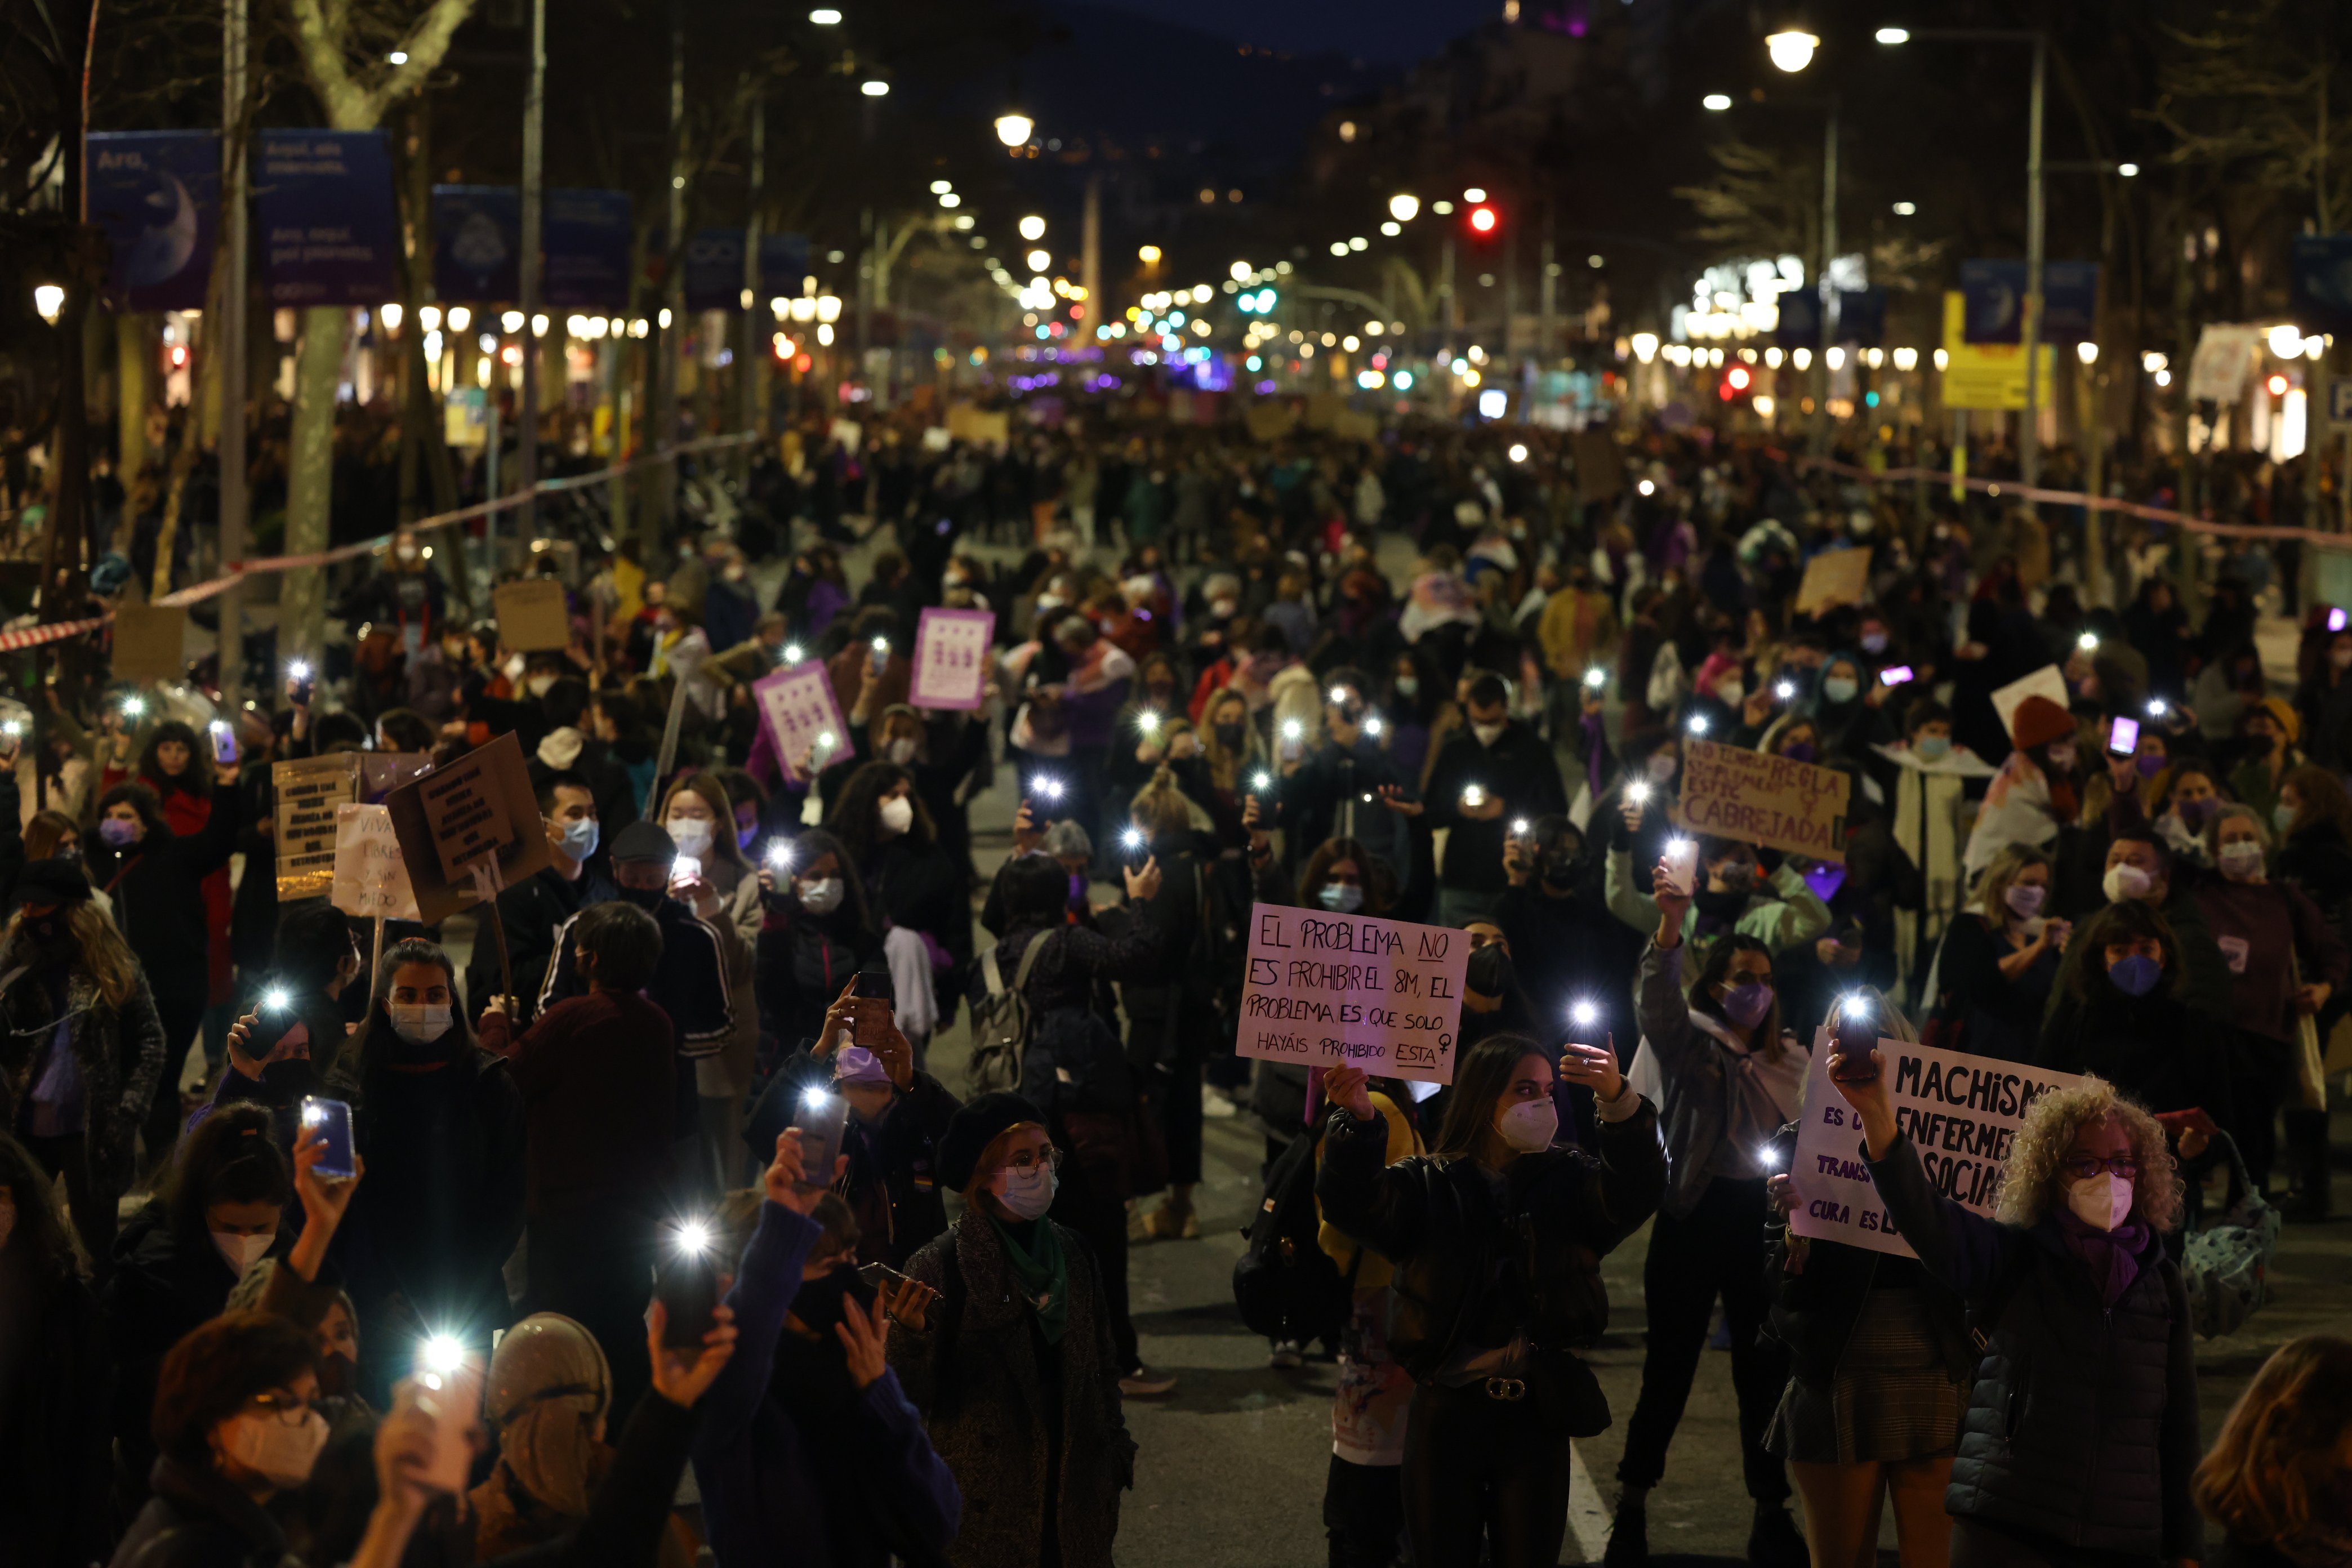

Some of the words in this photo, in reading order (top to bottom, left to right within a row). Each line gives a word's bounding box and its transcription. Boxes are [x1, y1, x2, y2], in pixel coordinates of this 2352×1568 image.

[1685, 795, 1829, 850] CABREJADA
[1262, 915, 1291, 948] EL
[1301, 919, 1404, 956] PROBLEMA
[1418, 932, 1448, 958] NO
[1249, 958, 1280, 985] ES
[1289, 961, 1360, 991] PROHIBIR
[1365, 966, 1384, 990] EL
[1395, 969, 1420, 998] 8M,
[1429, 977, 1454, 999] EL
[1246, 994, 1334, 1023] PROBLEMA
[1340, 1005, 1362, 1022] ES
[1369, 1008, 1398, 1027] QUE
[1404, 1014, 1443, 1030] SOLO
[1258, 1032, 1308, 1052] HAYÁIS
[1320, 1038, 1386, 1058] PROHIBIDO
[1396, 1044, 1436, 1064] ESTA
[1824, 1107, 1843, 1126] ES
[1895, 1106, 2016, 1161] ENFERME
[1818, 1154, 1871, 1183] TRANS
[1810, 1200, 1850, 1224] CURA
[1859, 1210, 1878, 1231] ES
